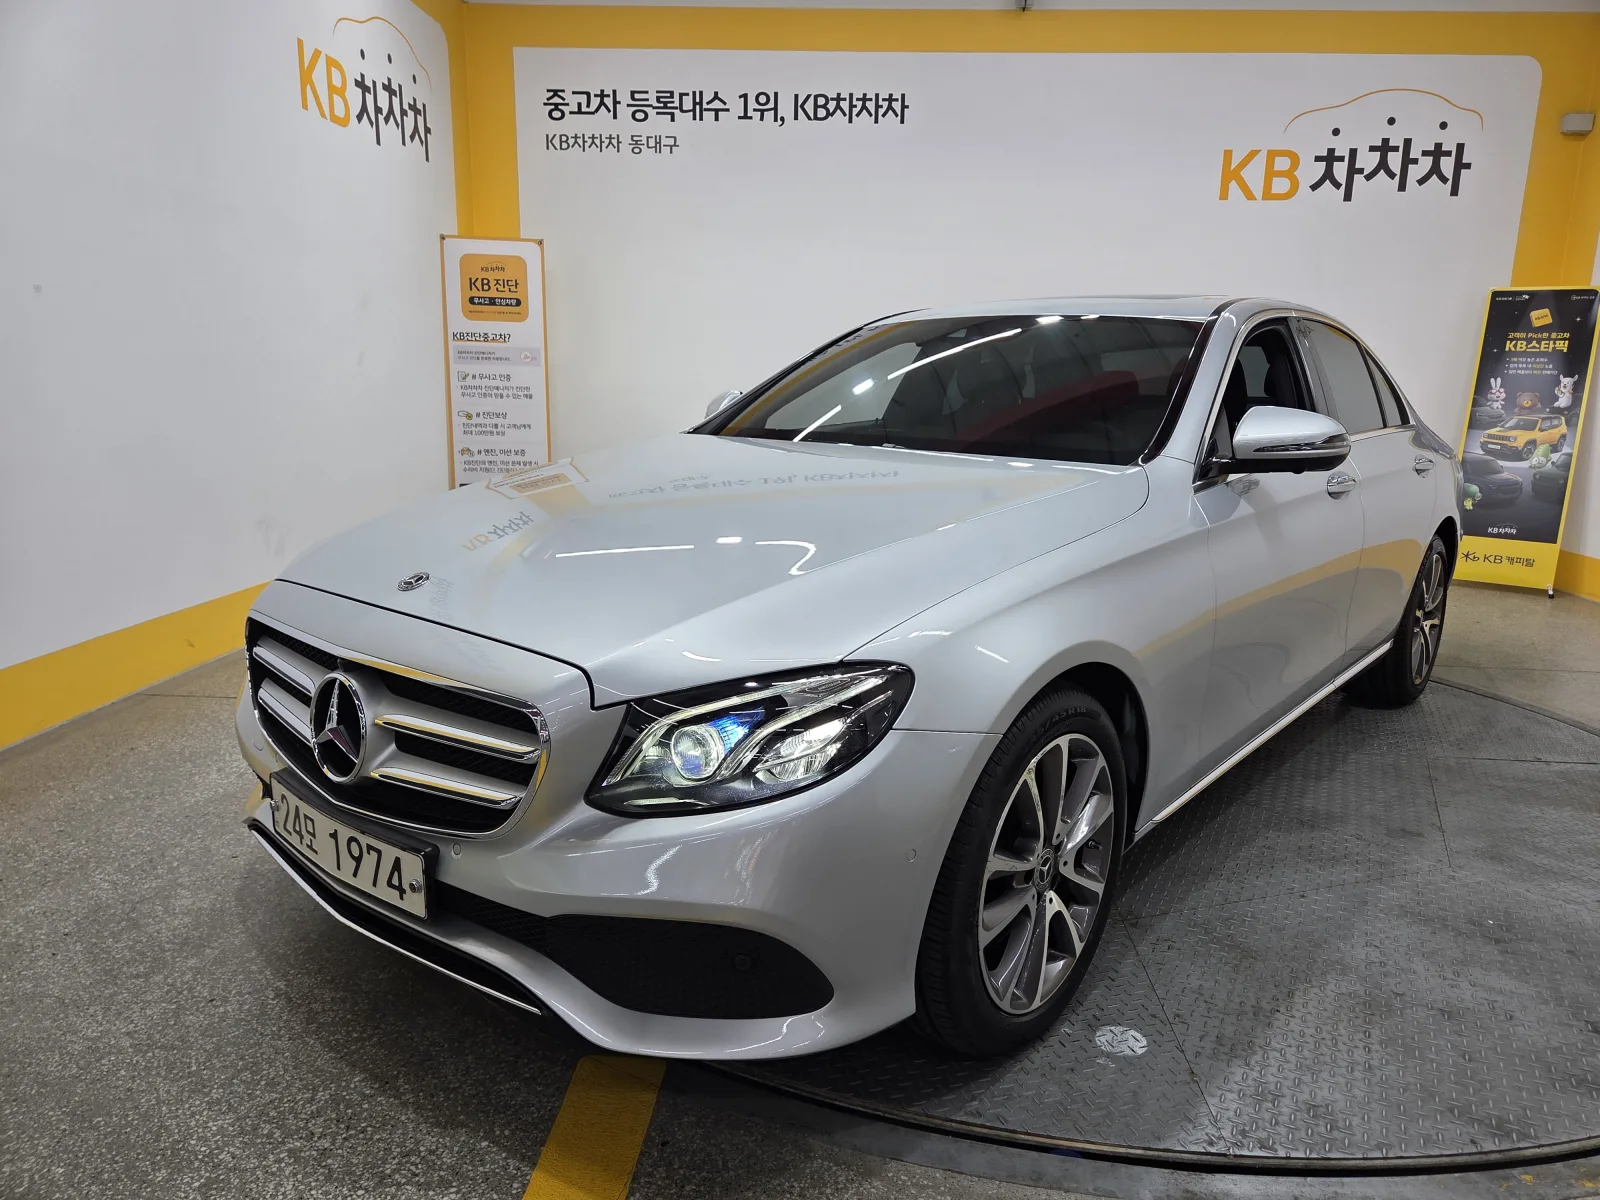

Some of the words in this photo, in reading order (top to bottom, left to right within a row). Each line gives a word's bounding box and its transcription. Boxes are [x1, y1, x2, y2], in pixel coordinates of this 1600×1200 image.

[543, 89, 622, 121] 중고차
[627, 90, 730, 122] 등록대수
[738, 91, 786, 128] 1위,
[793, 92, 910, 124] KB차차차
[546, 134, 622, 153] KB차차차
[628, 134, 680, 155] 동대구
[469, 277, 492, 292] KB
[494, 279, 520, 294] 진단
[452, 332, 512, 343] KB진단중고차?
[1505, 340, 1569, 353] KB스타픽
[499, 374, 512, 382] 인증
[482, 412, 508, 420] 진단보상
[484, 449, 499, 457] 엔진,
[514, 449, 526, 457] 보증
[1483, 554, 1503, 564] KB
[1506, 556, 1536, 568] 캐피탈
[281, 793, 319, 856] 24모
[329, 829, 406, 901] 1974
